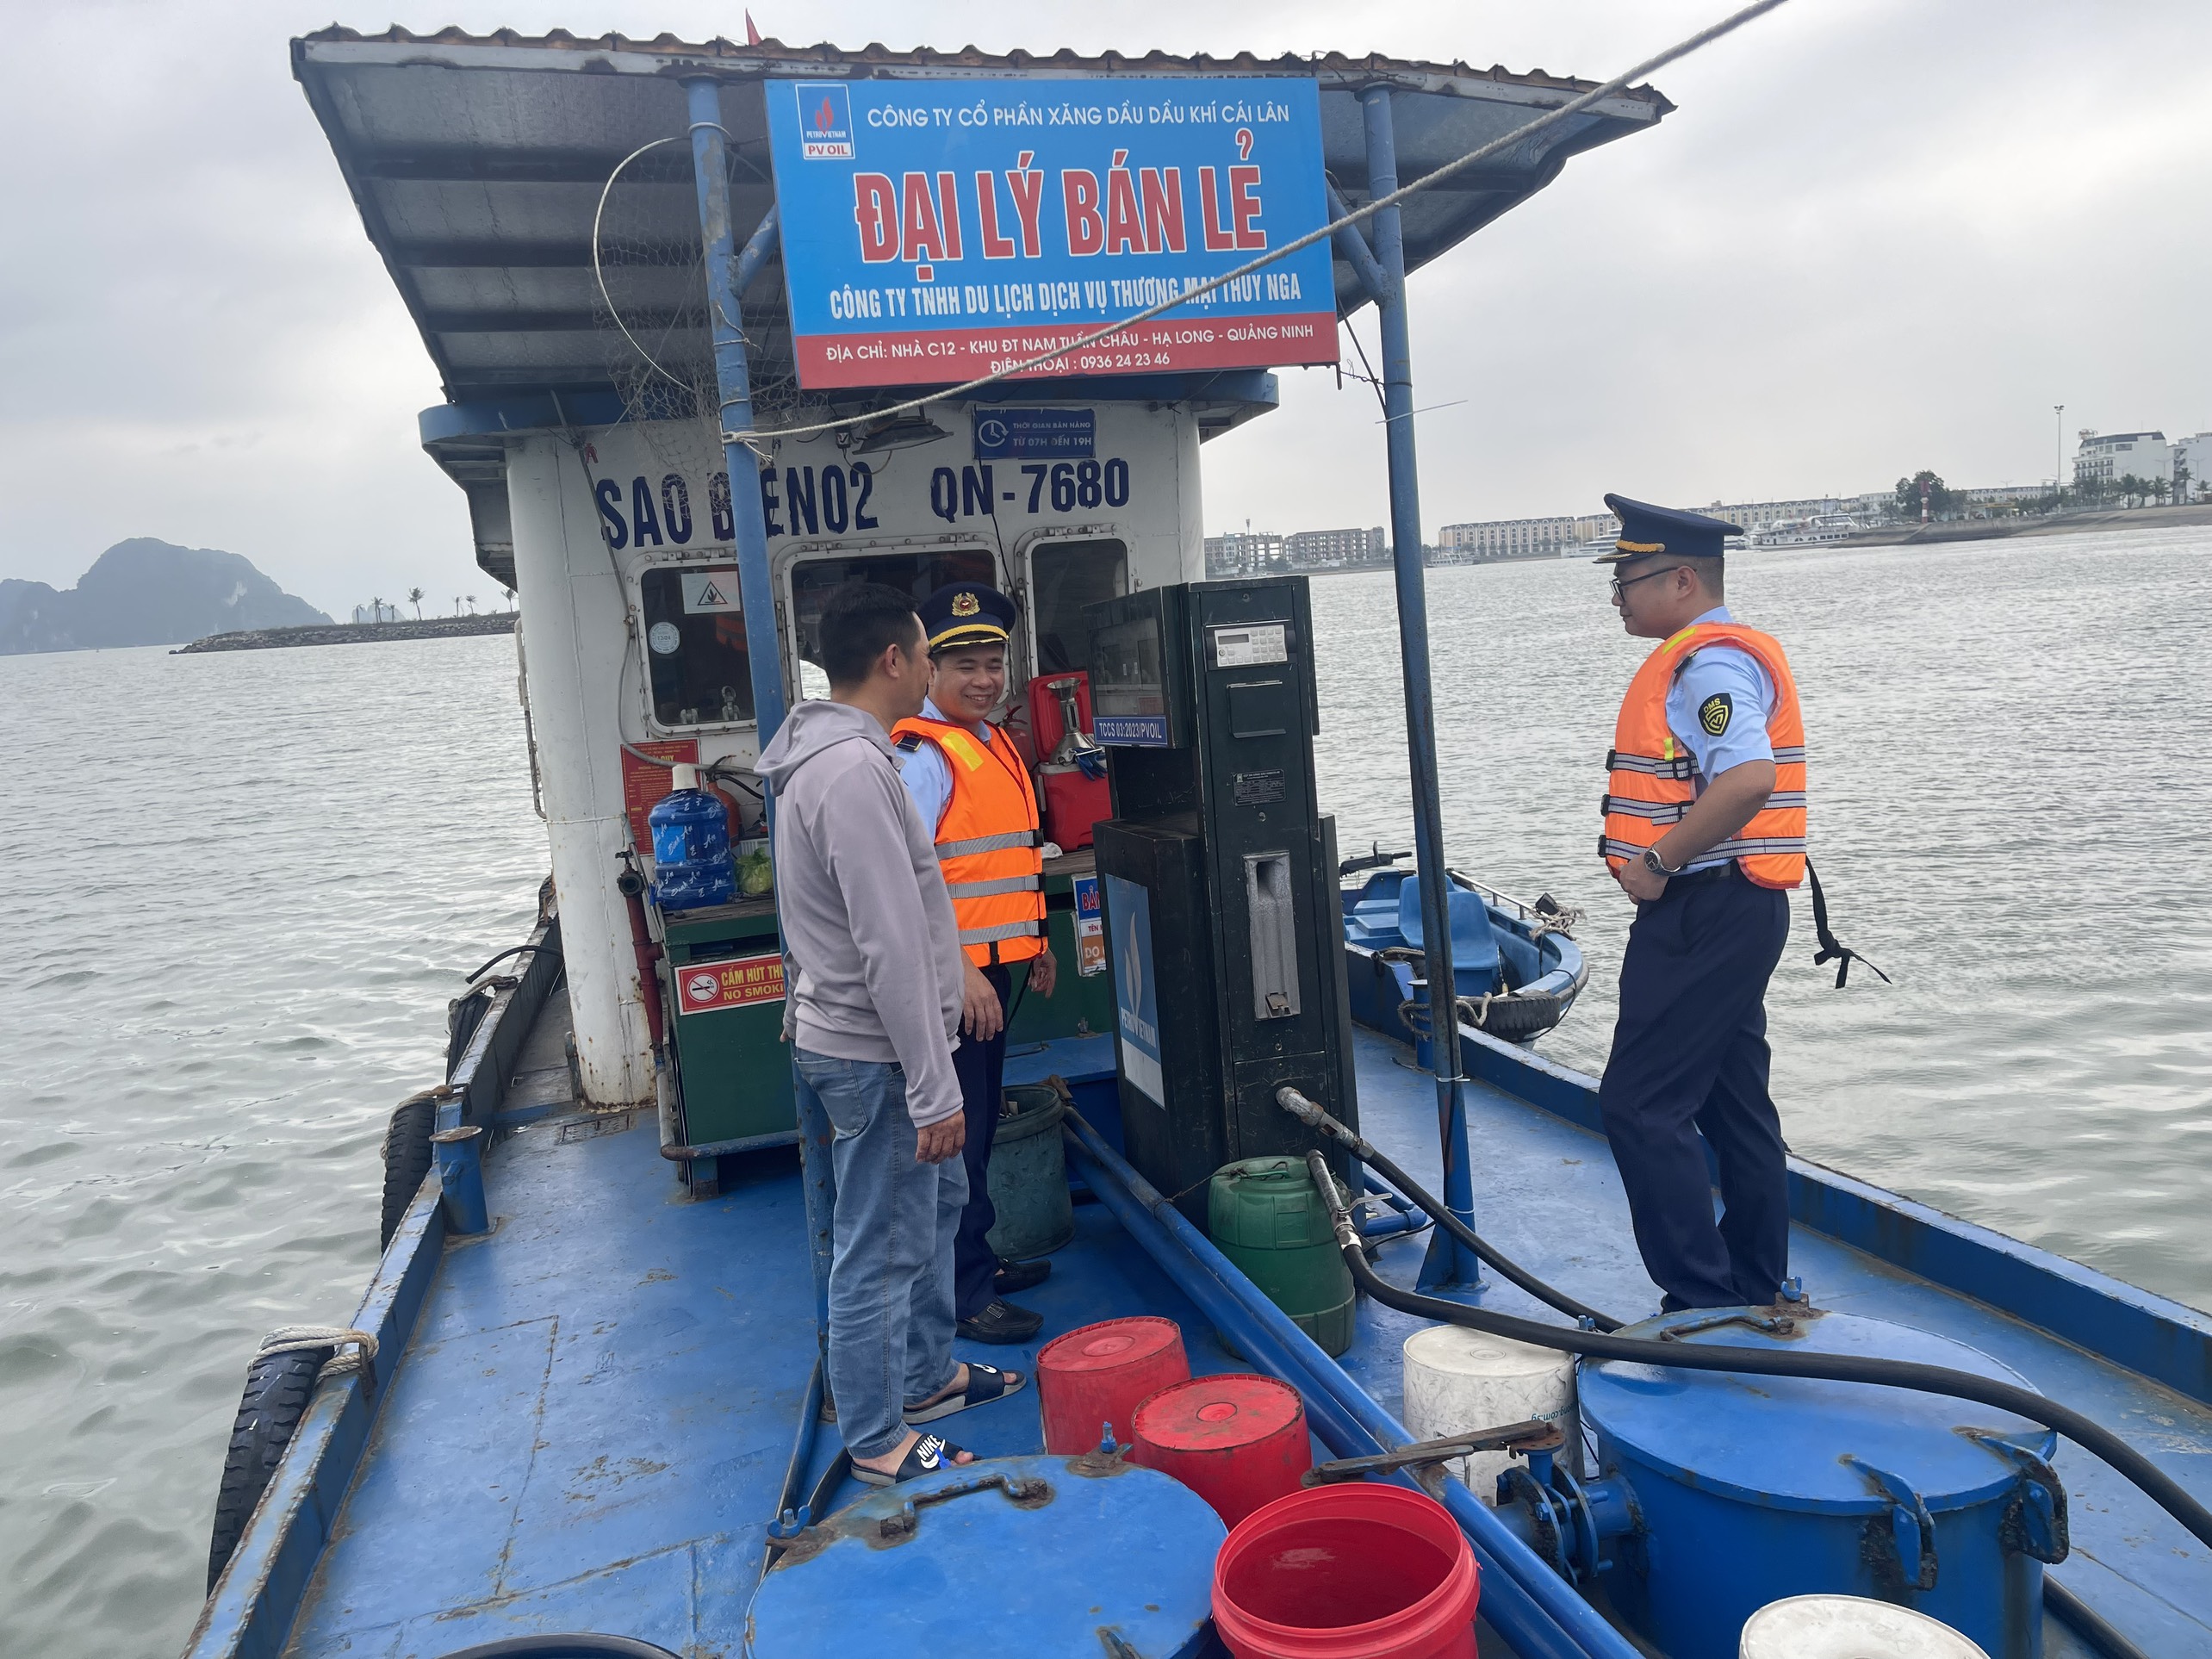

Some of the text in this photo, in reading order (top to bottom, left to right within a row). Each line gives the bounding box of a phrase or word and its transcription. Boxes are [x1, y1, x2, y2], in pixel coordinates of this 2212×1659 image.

[867, 99, 1289, 127] CÔNG TY CỔ PHẦN XĂNG DẦU DẦU KHÍ CÁI LÂN
[808, 145, 848, 155] PV OIL
[854, 127, 1267, 283] ĐẠI LÝ BÁN LẺ
[830, 283, 882, 320] CÔNG
[885, 288, 905, 317] TY
[911, 286, 960, 316] TNHH
[964, 285, 989, 314] DU
[994, 283, 1035, 319] LỊCH
[1038, 282, 1081, 317] DỊCH
[1084, 280, 1107, 314] VỤ
[1111, 276, 1178, 308] THƯƠNG
[1184, 276, 1217, 310] MẠI
[1266, 273, 1302, 300] NGA
[826, 345, 854, 363] ĐỊA
[857, 340, 887, 359] CHỈ:
[892, 340, 924, 358] NHÀ
[927, 342, 956, 356] C12
[969, 339, 997, 354] KHU
[1001, 339, 1019, 353] ĐT
[1022, 337, 1057, 351] NAM
[1099, 330, 1139, 348] CHÂU
[1153, 332, 1172, 348] HẠ
[1176, 329, 1215, 343] LONG
[1227, 323, 1278, 341] QUẢNG
[1282, 325, 1314, 339] NINH
[1080, 355, 1112, 370] 0936
[1115, 353, 1131, 368] 24
[1134, 353, 1151, 366] 23
[1154, 351, 1170, 365] 46
[1028, 438, 1047, 446] 07H
[1074, 437, 1091, 446] 19H
[596, 474, 693, 550] SAO
[1704, 698, 1721, 713] DMS
[1099, 722, 1115, 737] TCCS
[1088, 923, 1099, 932] TÊN
[1085, 946, 1100, 958] DO
[721, 966, 744, 986] CẤM
[747, 964, 765, 983] HÚT
[724, 990, 741, 1001] NO
[916, 1434, 941, 1461] NIKE
